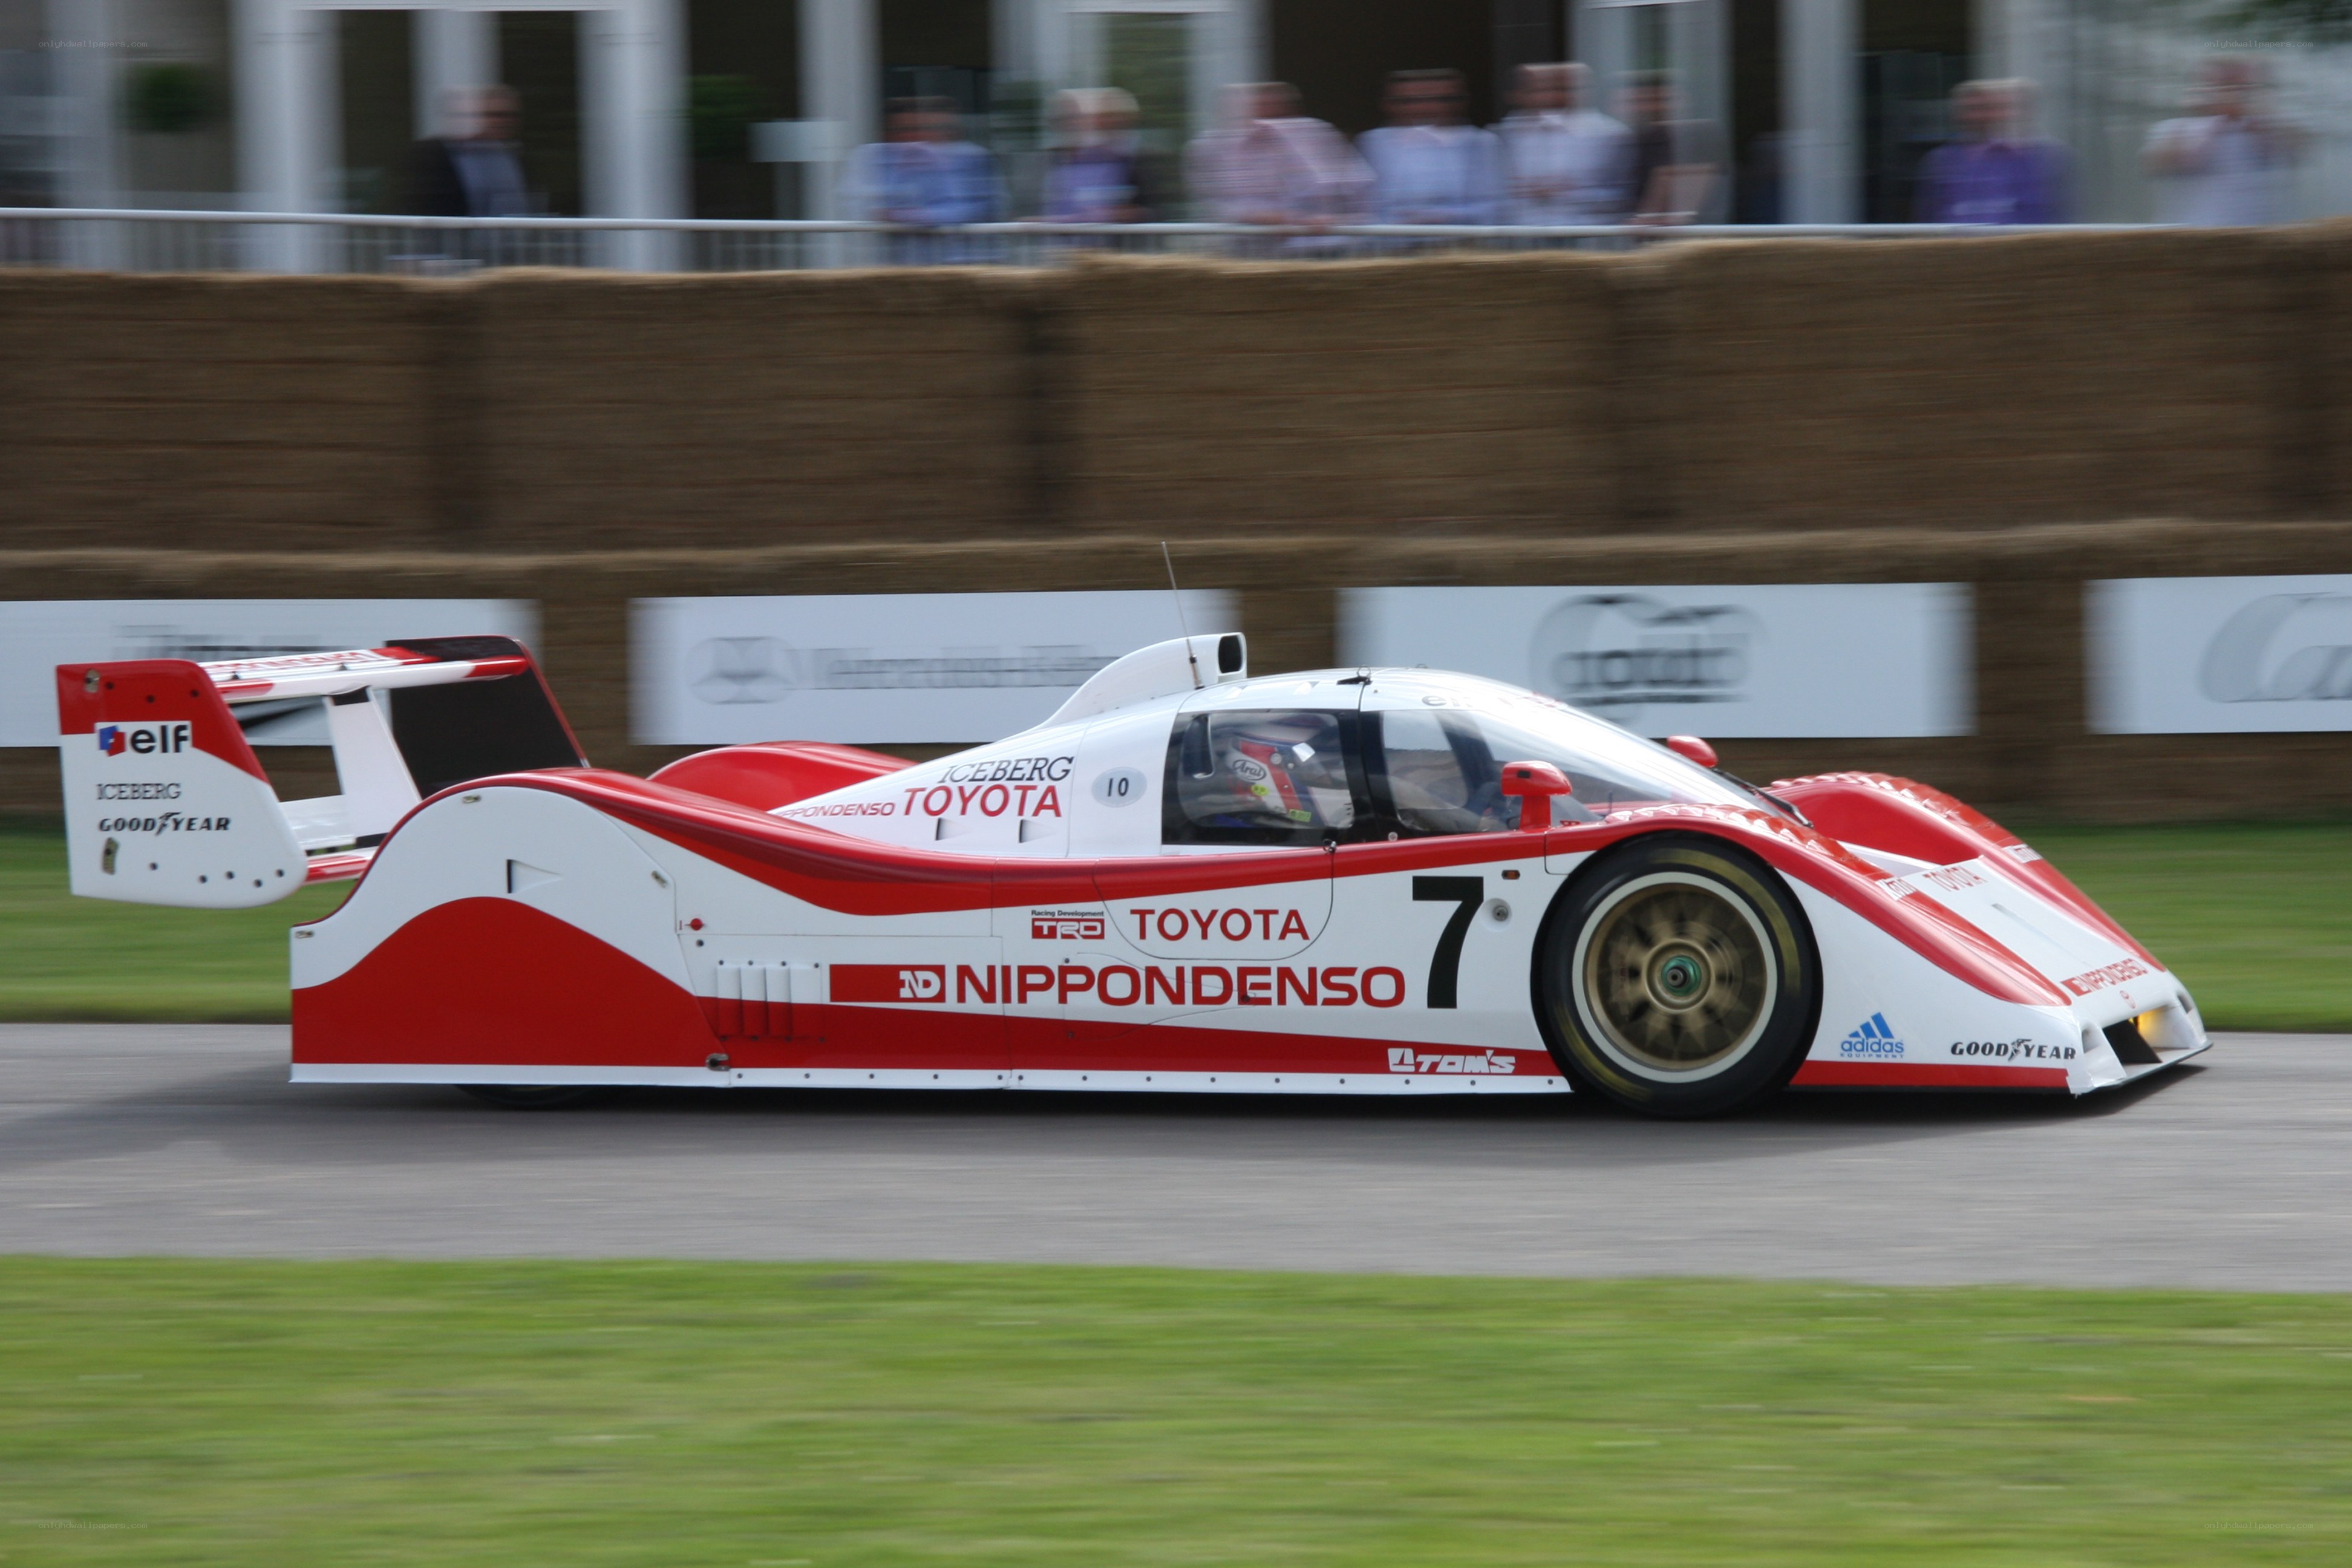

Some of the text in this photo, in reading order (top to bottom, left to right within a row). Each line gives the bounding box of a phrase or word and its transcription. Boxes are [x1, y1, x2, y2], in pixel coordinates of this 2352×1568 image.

[130, 725, 189, 754] elf
[937, 756, 1074, 784] ICEBERG
[96, 783, 181, 800] ICEBERG
[778, 785, 1061, 817] PPONDENSO TOYOTA
[1108, 777, 1129, 797] 10
[1034, 920, 1102, 939] TRD
[1130, 908, 1310, 941] TOYOTA
[1413, 876, 1484, 1008] 7
[956, 964, 1405, 1008] NIPPONDENSO
[1841, 1038, 1904, 1053] adidas
